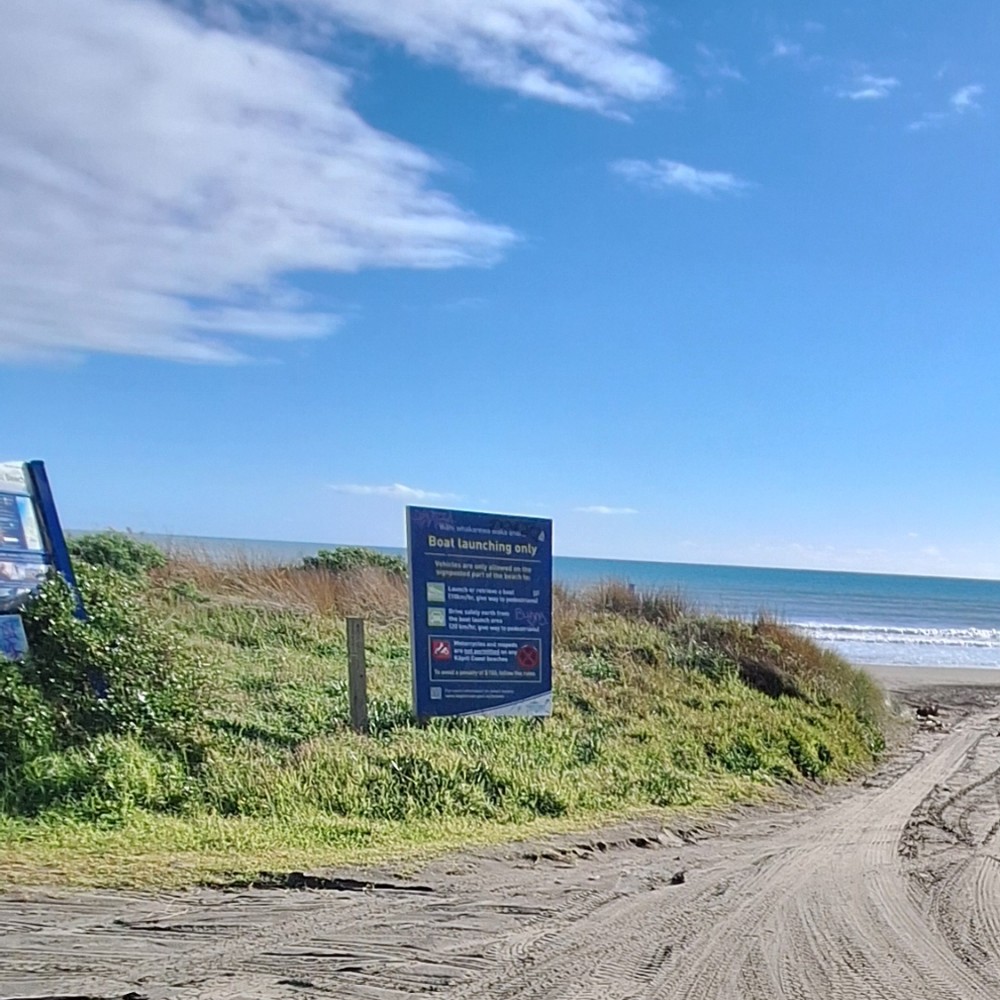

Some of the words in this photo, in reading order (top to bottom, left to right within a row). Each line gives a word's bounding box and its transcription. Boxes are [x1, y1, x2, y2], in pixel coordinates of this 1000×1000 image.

[428, 534, 455, 549] Boat
[457, 537, 513, 556] launching
[514, 542, 538, 558] only
[434, 560, 462, 569] Vehicles
[474, 563, 487, 572] only
[488, 564, 513, 572] allowed
[521, 566, 532, 574] the
[471, 571, 485, 579] part
[464, 609, 480, 617] safely
[453, 640, 486, 648] Motorcycles
